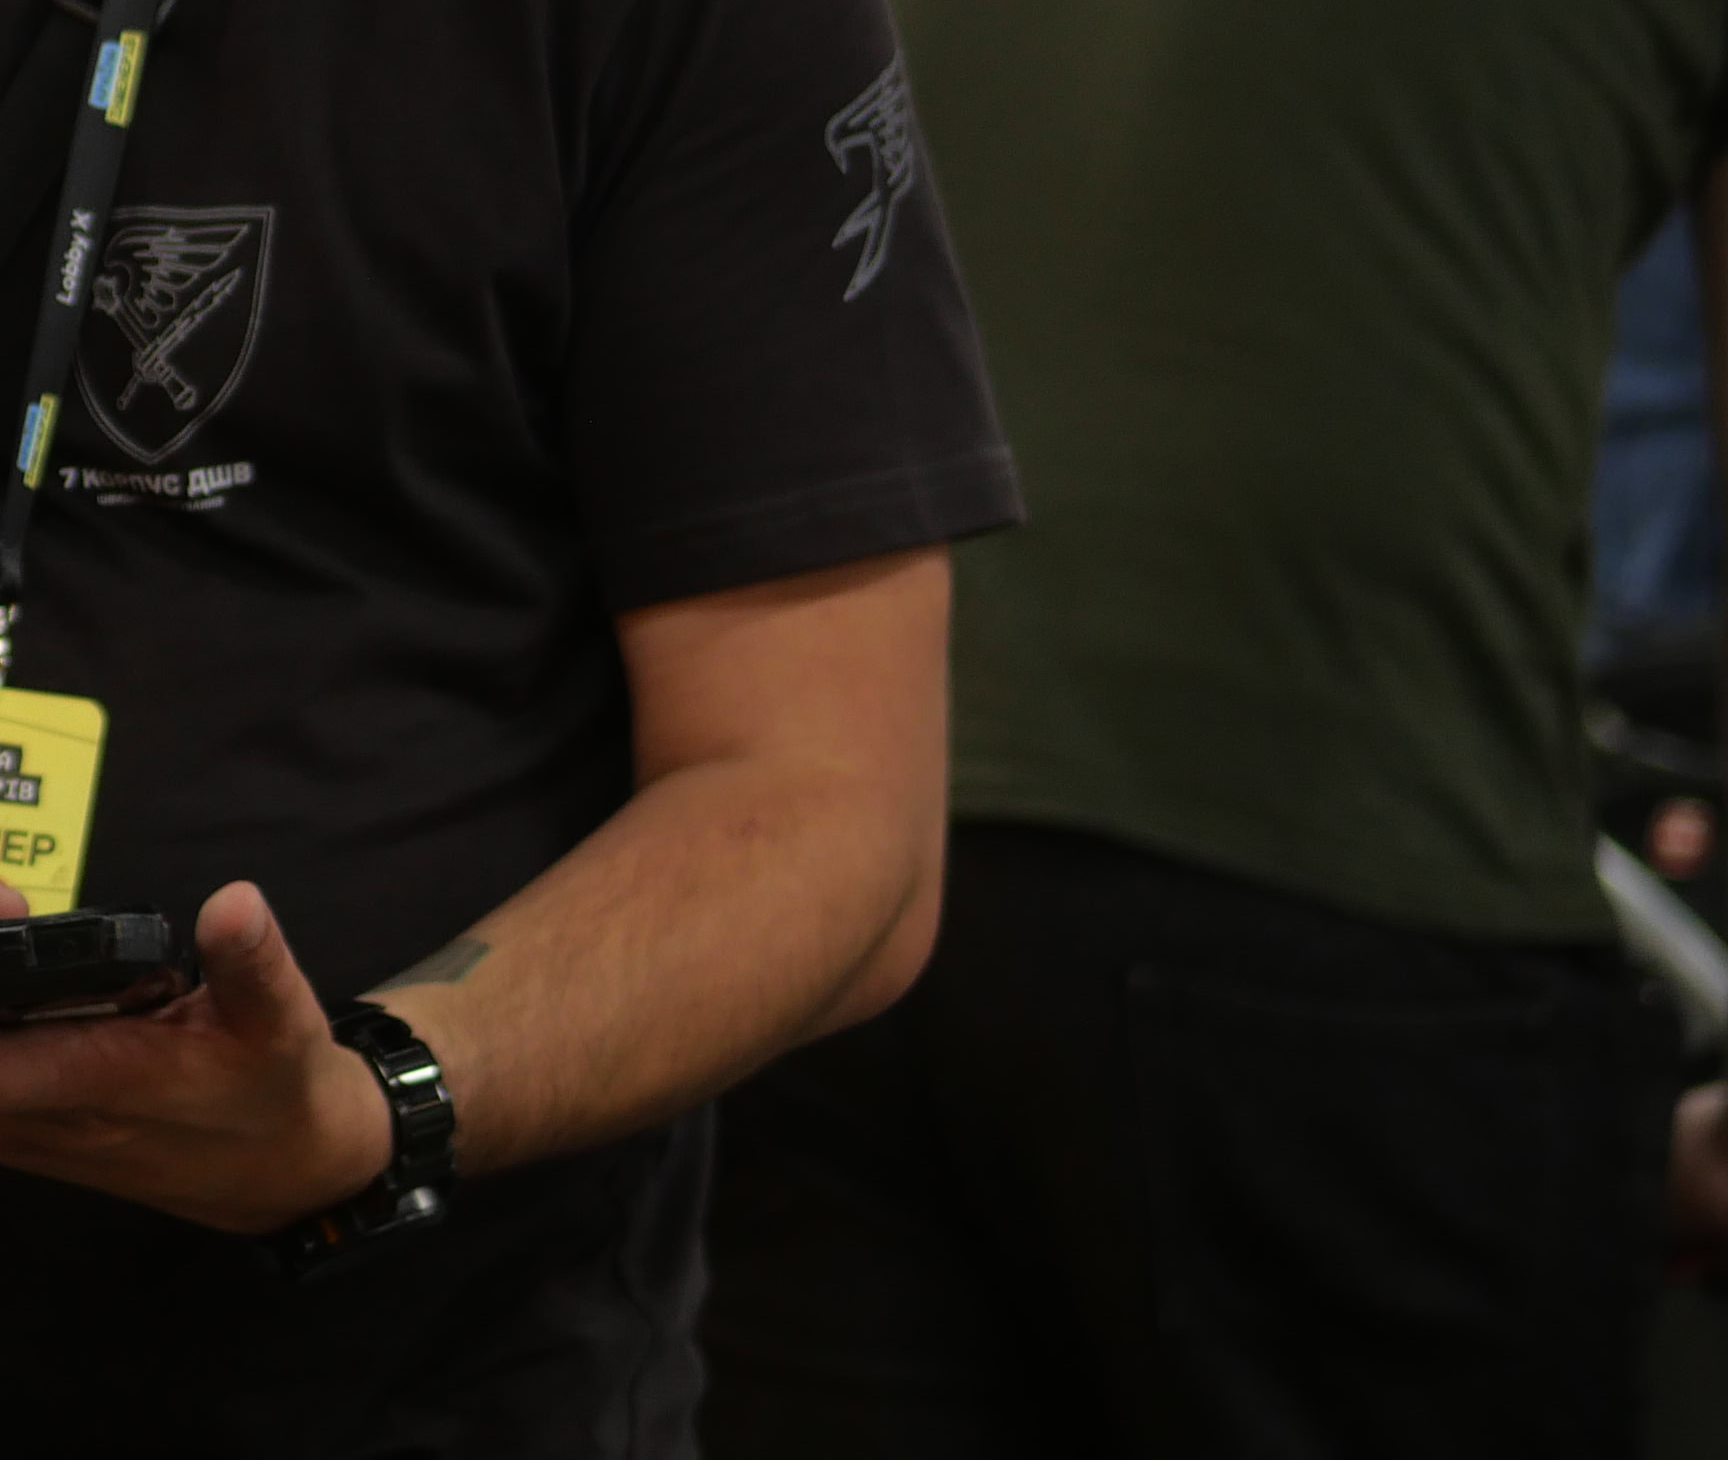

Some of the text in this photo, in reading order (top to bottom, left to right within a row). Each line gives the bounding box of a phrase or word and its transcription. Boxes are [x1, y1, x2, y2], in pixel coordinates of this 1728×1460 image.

[55, 207, 94, 306] Lobby X
[59, 466, 79, 490] 7
[187, 460, 253, 498] ДШВ
